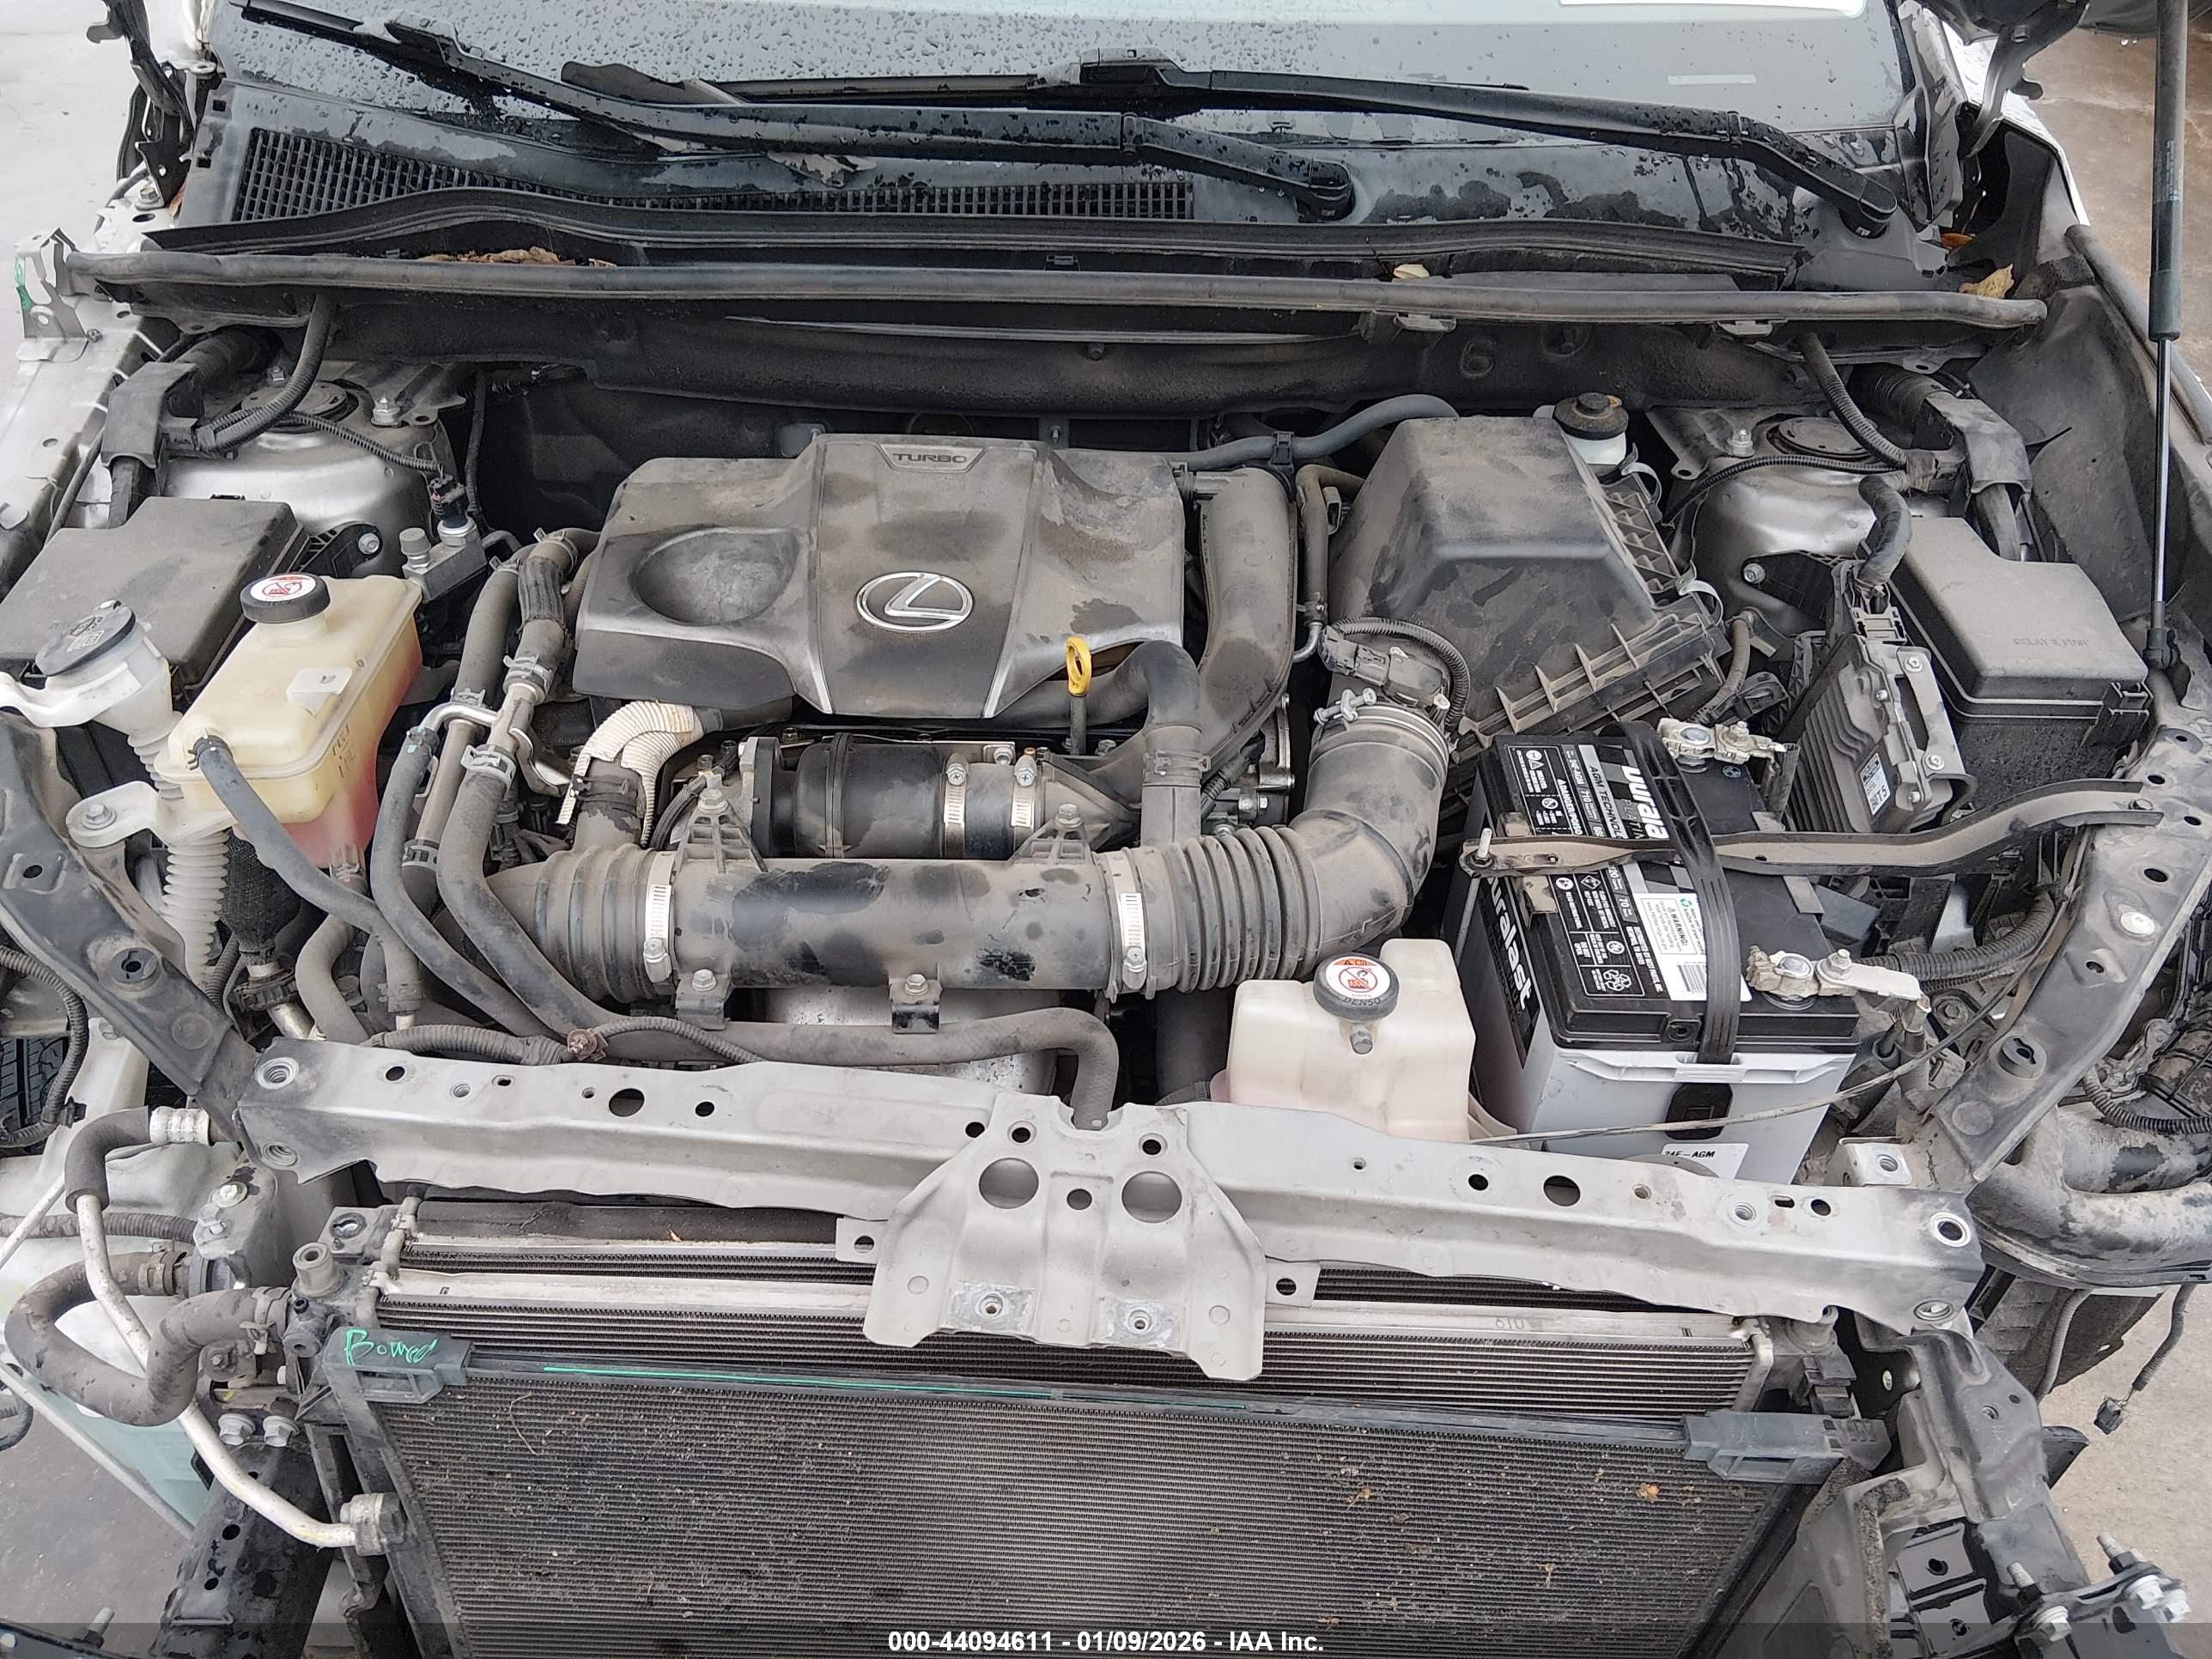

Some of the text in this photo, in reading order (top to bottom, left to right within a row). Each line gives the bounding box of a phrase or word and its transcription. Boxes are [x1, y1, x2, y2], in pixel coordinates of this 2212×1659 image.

[893, 453, 968, 463] TURBO
[1589, 766, 1606, 788] AGM
[1579, 789, 1592, 803] 710
[1621, 764, 1669, 839] Durala
[1559, 782, 1583, 836] DANGER/POISO
[1618, 897, 1630, 908] 70
[1670, 913, 1687, 946] WARNING:
[1342, 997, 1382, 1006] DENSO
